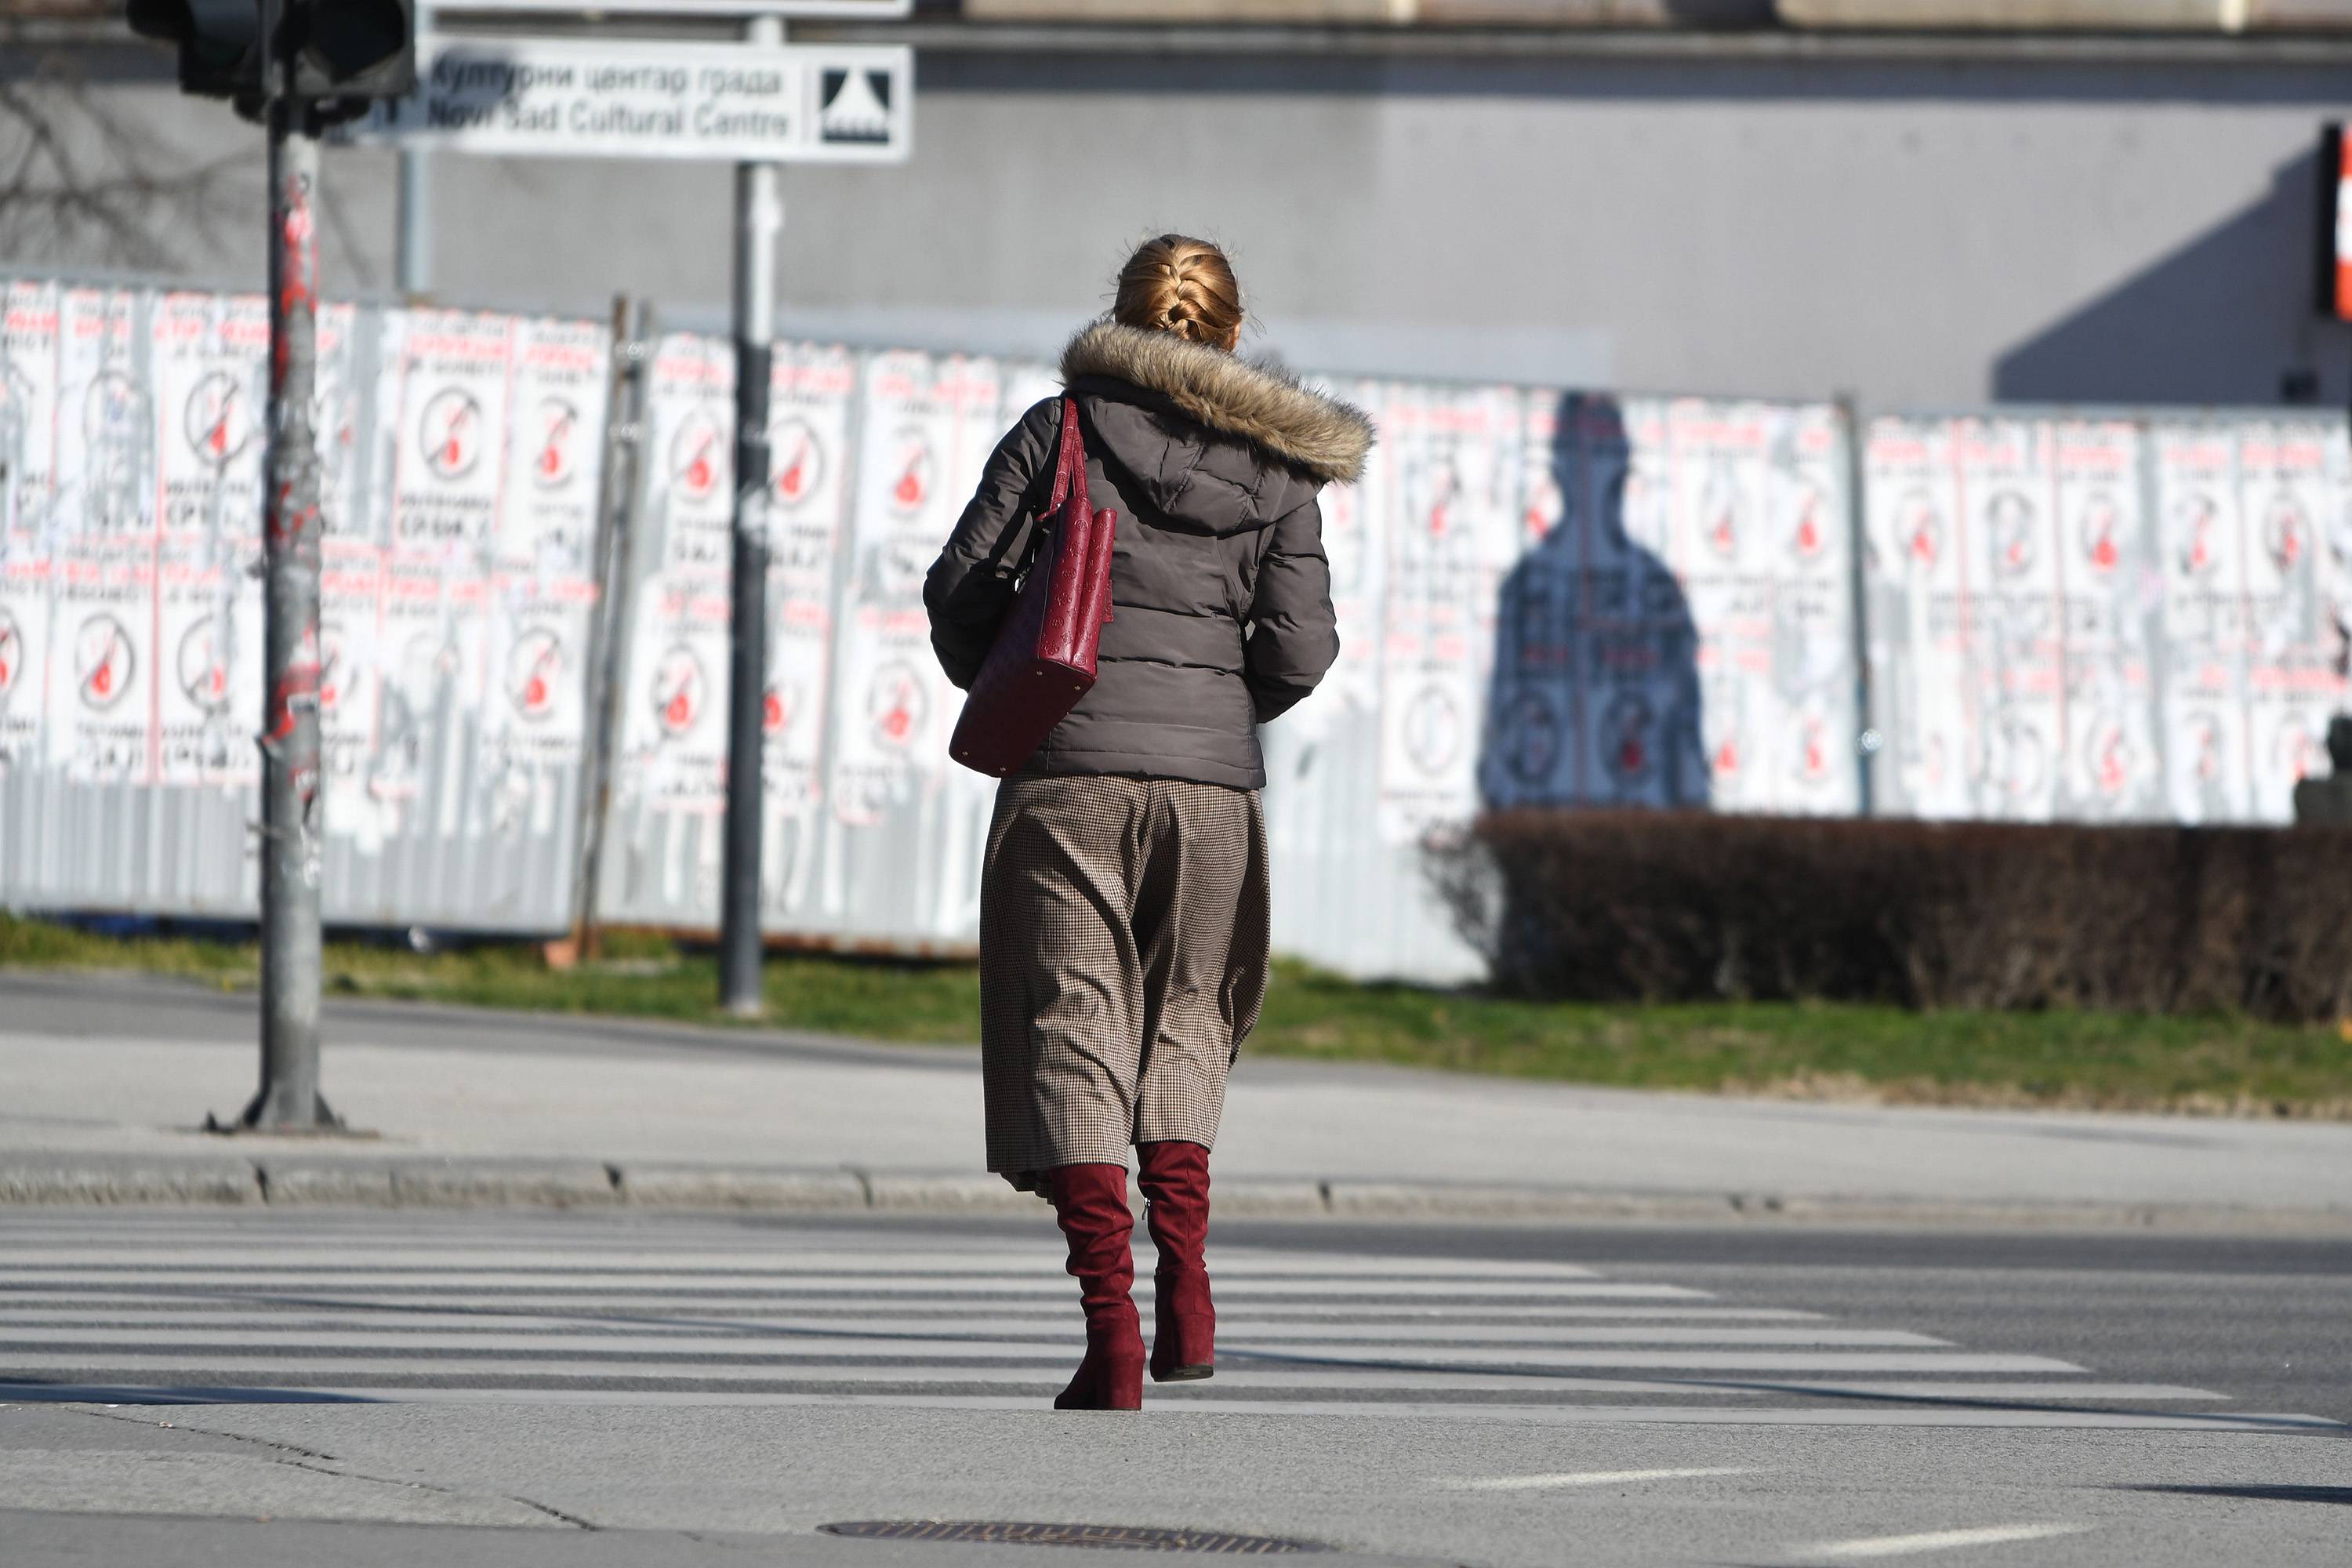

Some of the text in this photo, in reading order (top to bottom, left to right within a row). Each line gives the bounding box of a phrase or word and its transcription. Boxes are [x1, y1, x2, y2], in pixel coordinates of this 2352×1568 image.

[583, 65, 688, 95] центар
[699, 68, 781, 96] града
[427, 98, 789, 137] Novi Sad Cultural Centre
